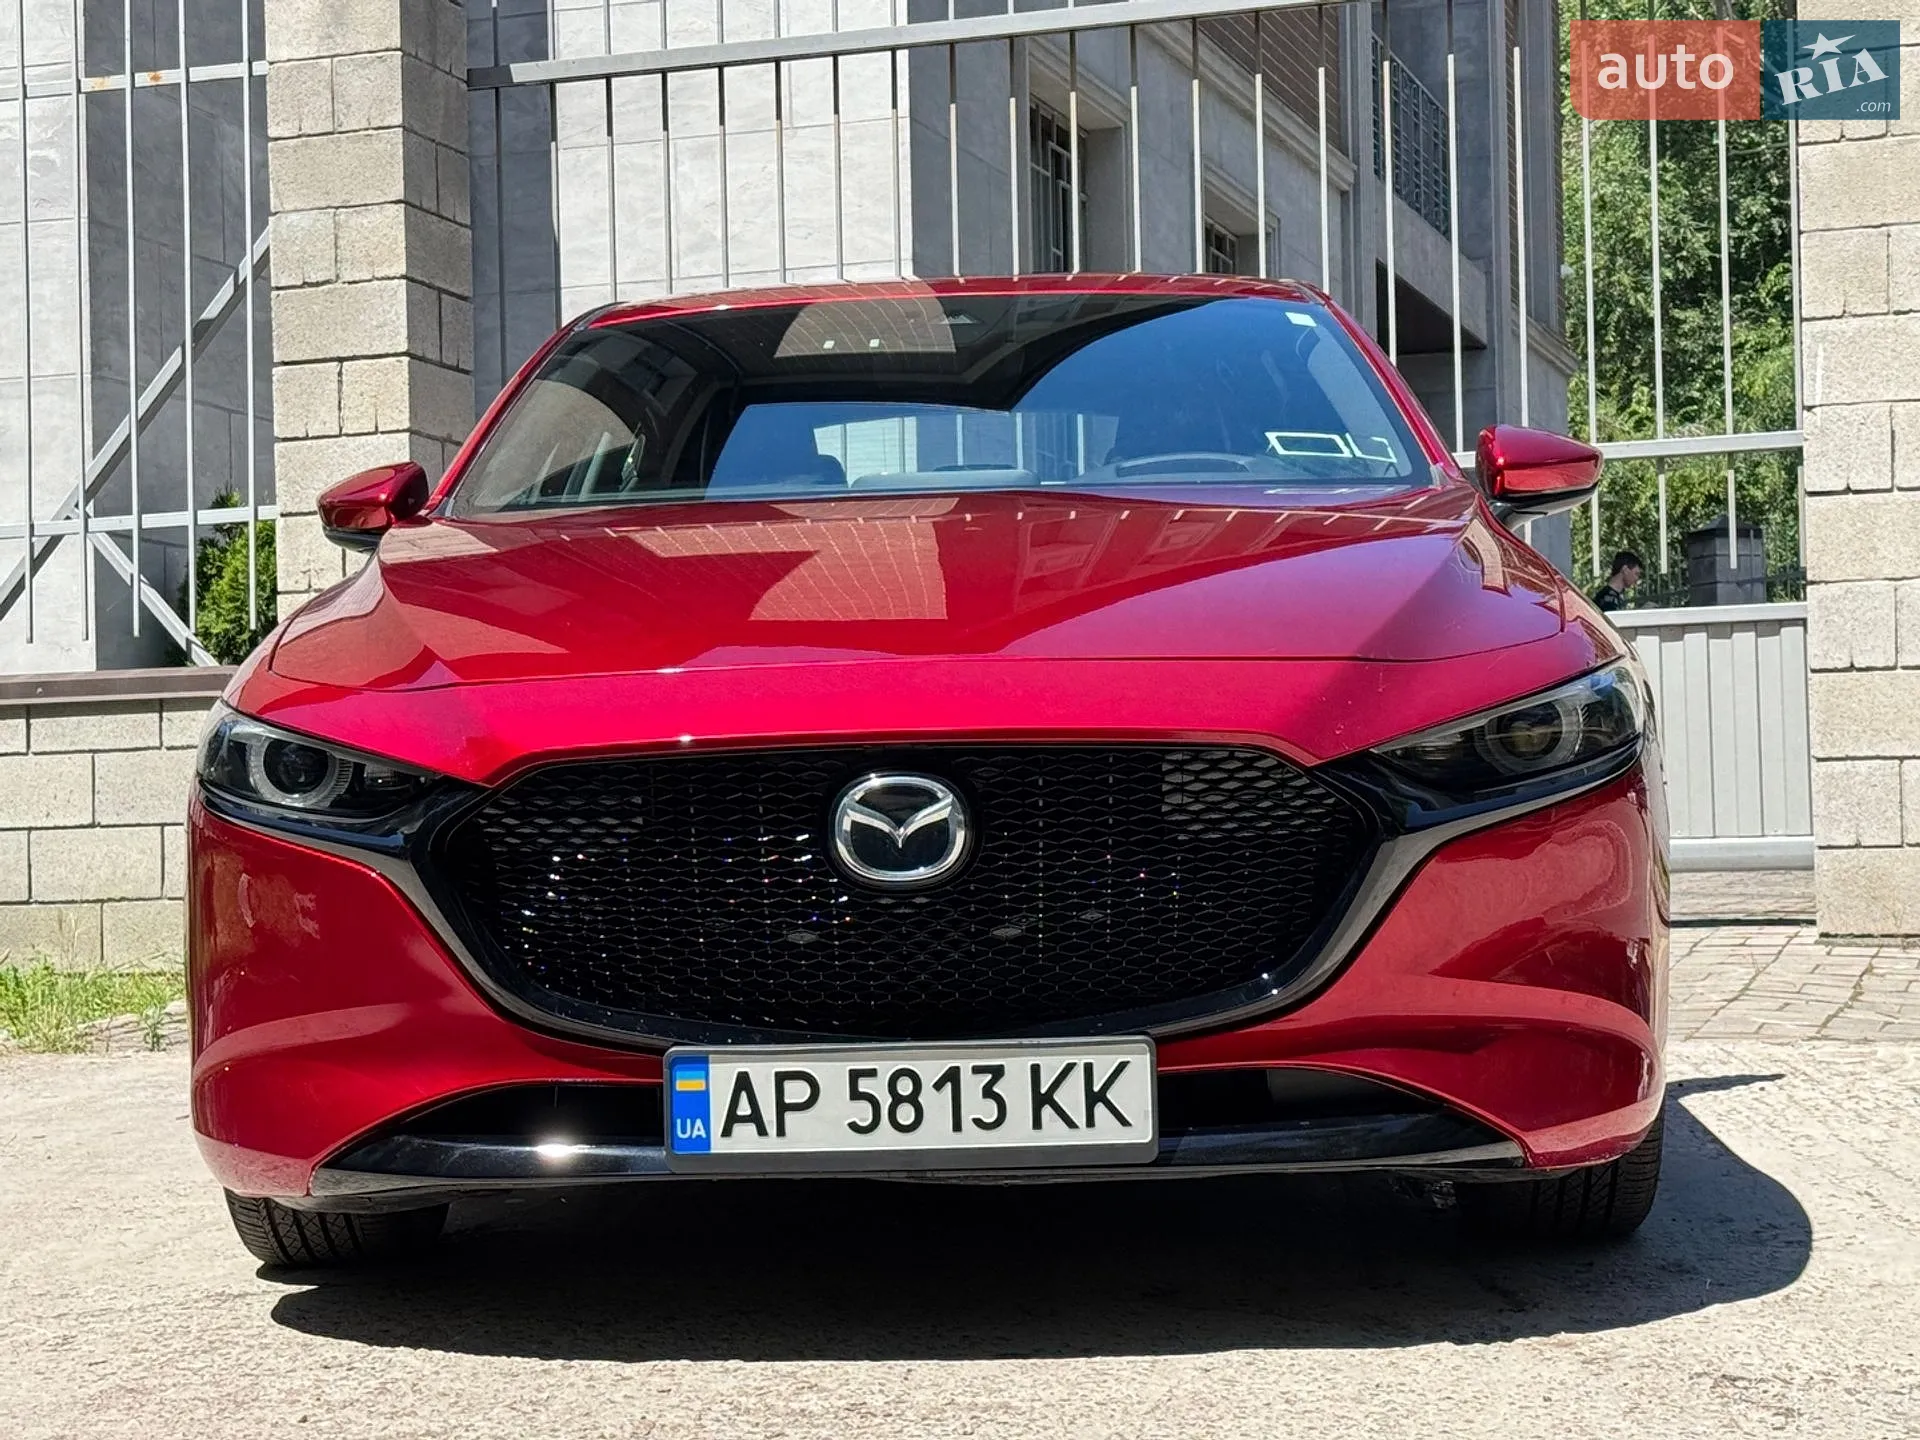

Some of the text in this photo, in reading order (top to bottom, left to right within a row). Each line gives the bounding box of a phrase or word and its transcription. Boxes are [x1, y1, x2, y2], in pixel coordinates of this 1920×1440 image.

[720, 1060, 1133, 1138] AP 5813 KK
[676, 1118, 707, 1139] UA
